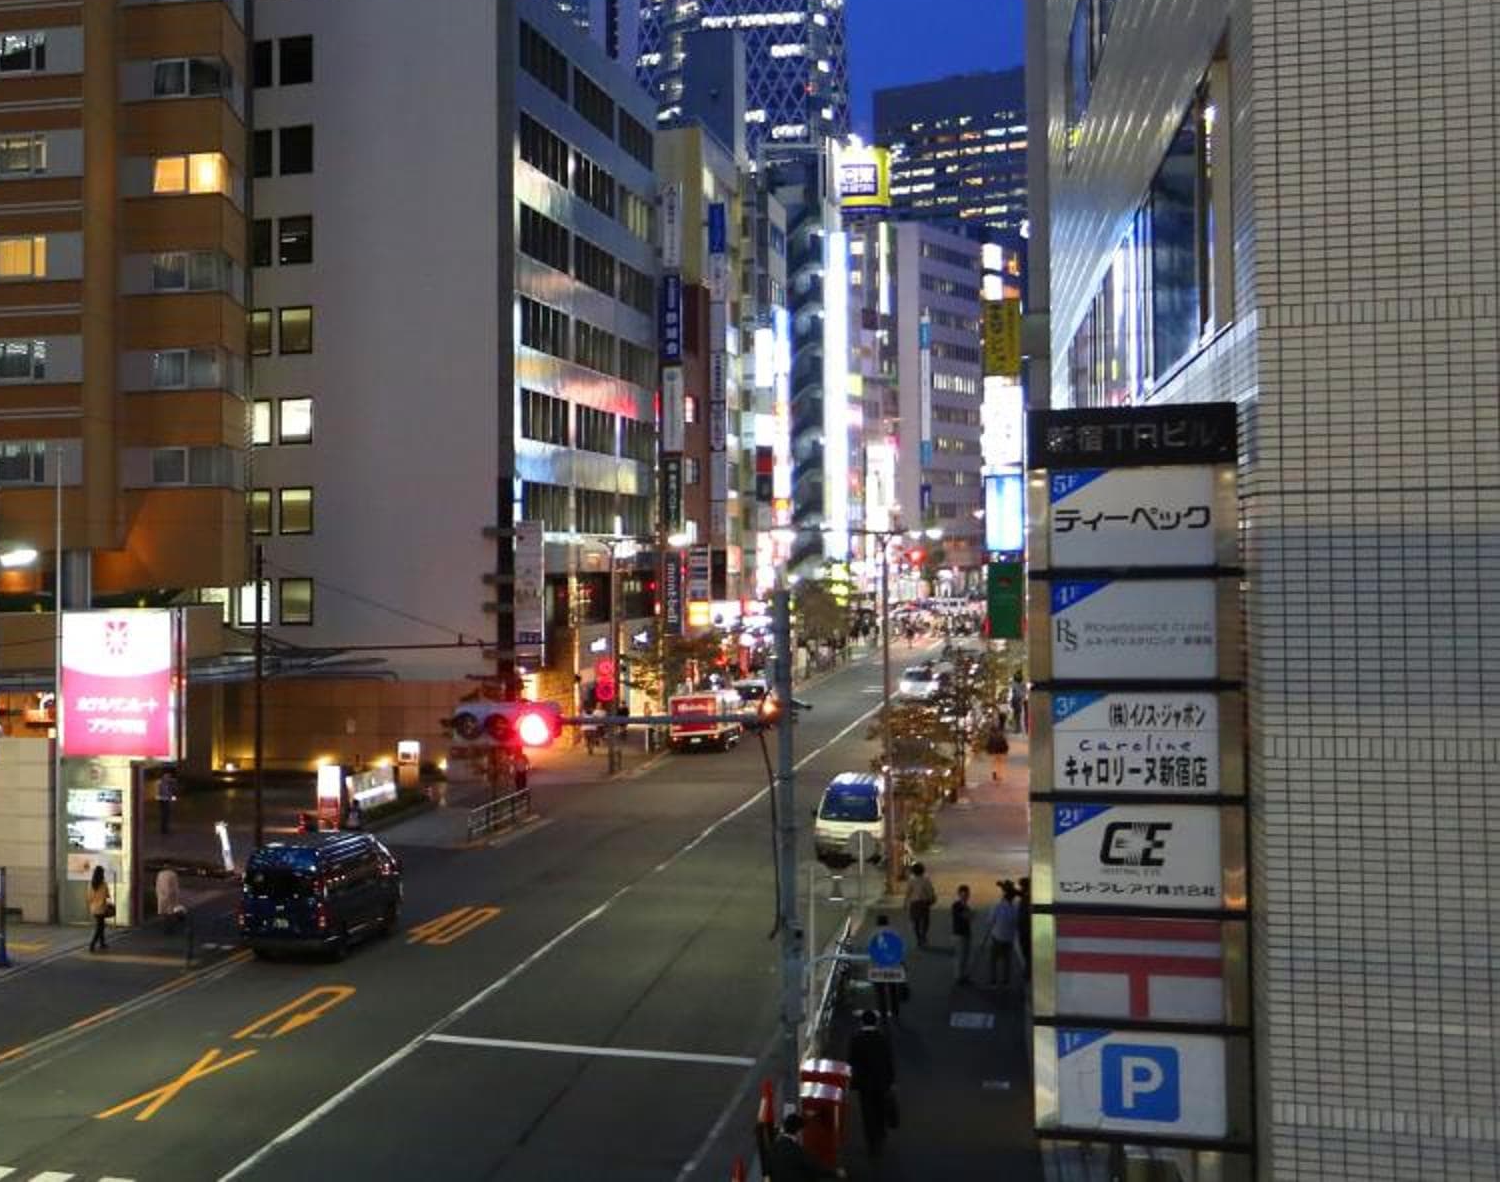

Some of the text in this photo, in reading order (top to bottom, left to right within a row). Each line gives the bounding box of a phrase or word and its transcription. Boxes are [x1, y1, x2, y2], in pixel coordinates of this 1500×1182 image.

[1053, 474, 1079, 494] 5F
[1054, 506, 1211, 533] ティーペック
[1056, 697, 1077, 716] 3F
[1079, 734, 1193, 752] caroline
[1065, 755, 1209, 787] キャロリーヌ新宿店
[1121, 1055, 1165, 1109] P
